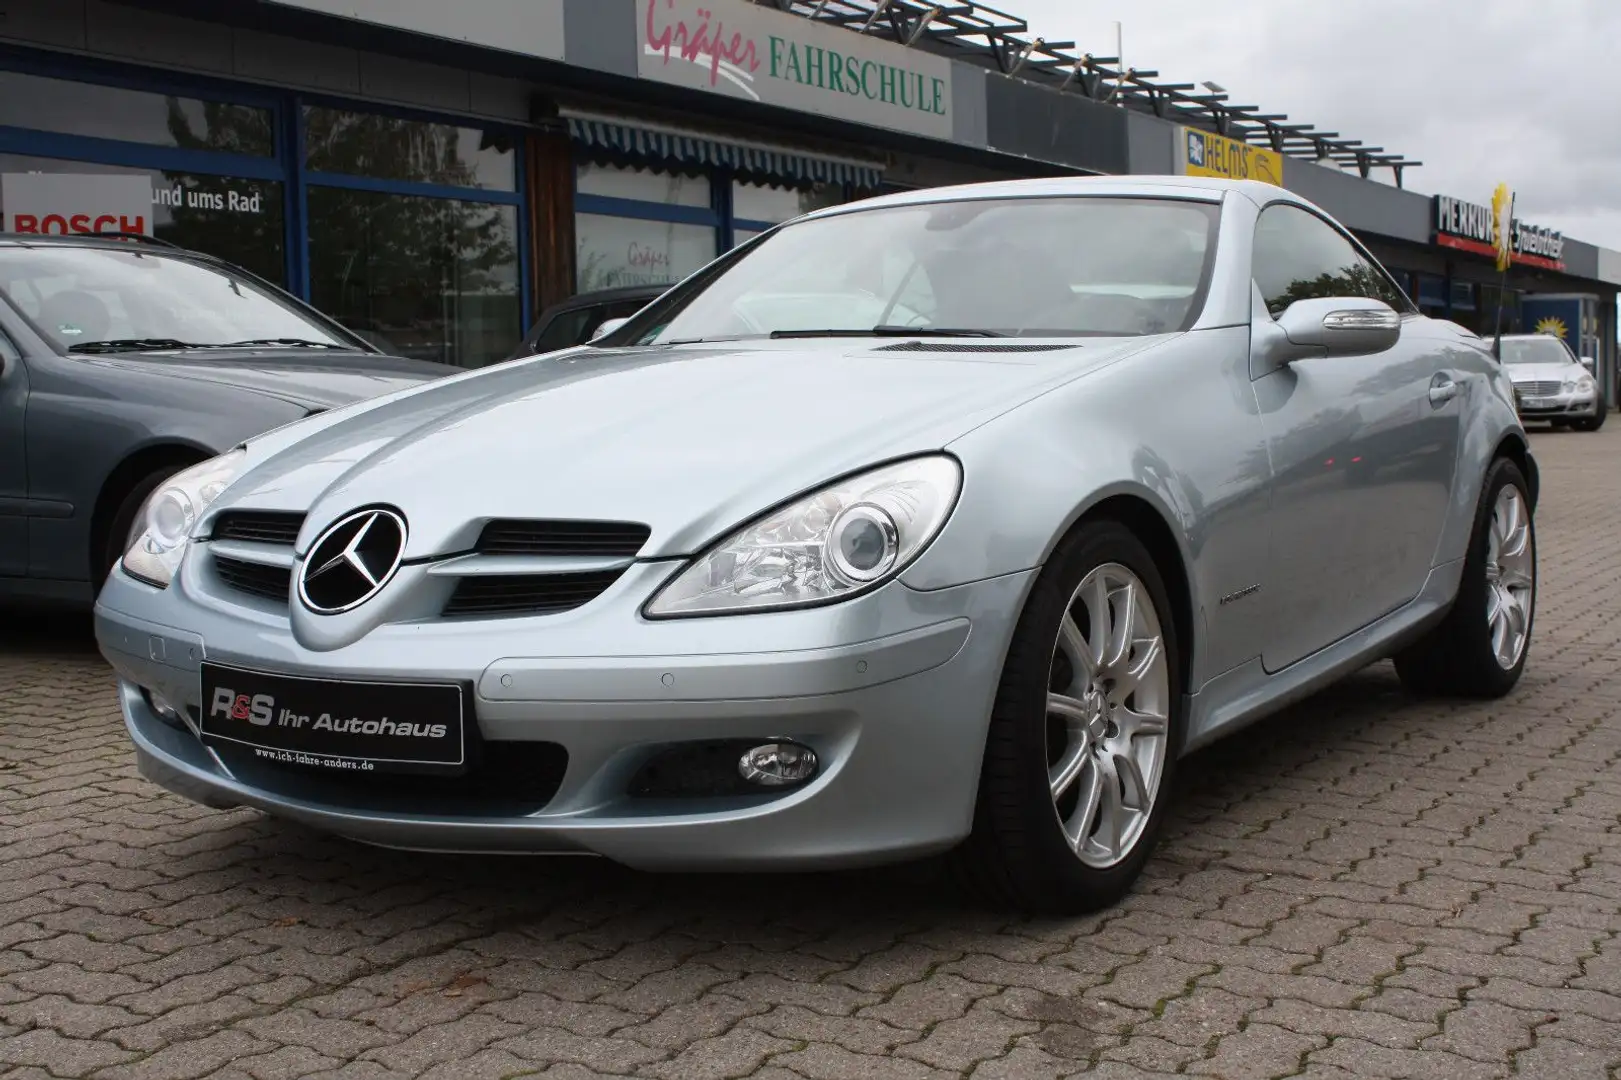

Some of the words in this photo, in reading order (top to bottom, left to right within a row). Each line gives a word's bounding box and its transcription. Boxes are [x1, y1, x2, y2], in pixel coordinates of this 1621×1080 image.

[645, 0, 761, 87] Gräper
[768, 35, 947, 116] FAHRSCHULE
[1206, 135, 1249, 179] HELMS
[188, 191, 224, 210] ums
[228, 190, 261, 213] Rad
[1439, 196, 1493, 242] MERKUR
[14, 213, 144, 243] BOSCH
[210, 686, 275, 727] R&S
[278, 708, 310, 729] Ihr
[312, 713, 448, 739] Autohaus
[254, 747, 375, 771] www.ich-fahre-anders.de
